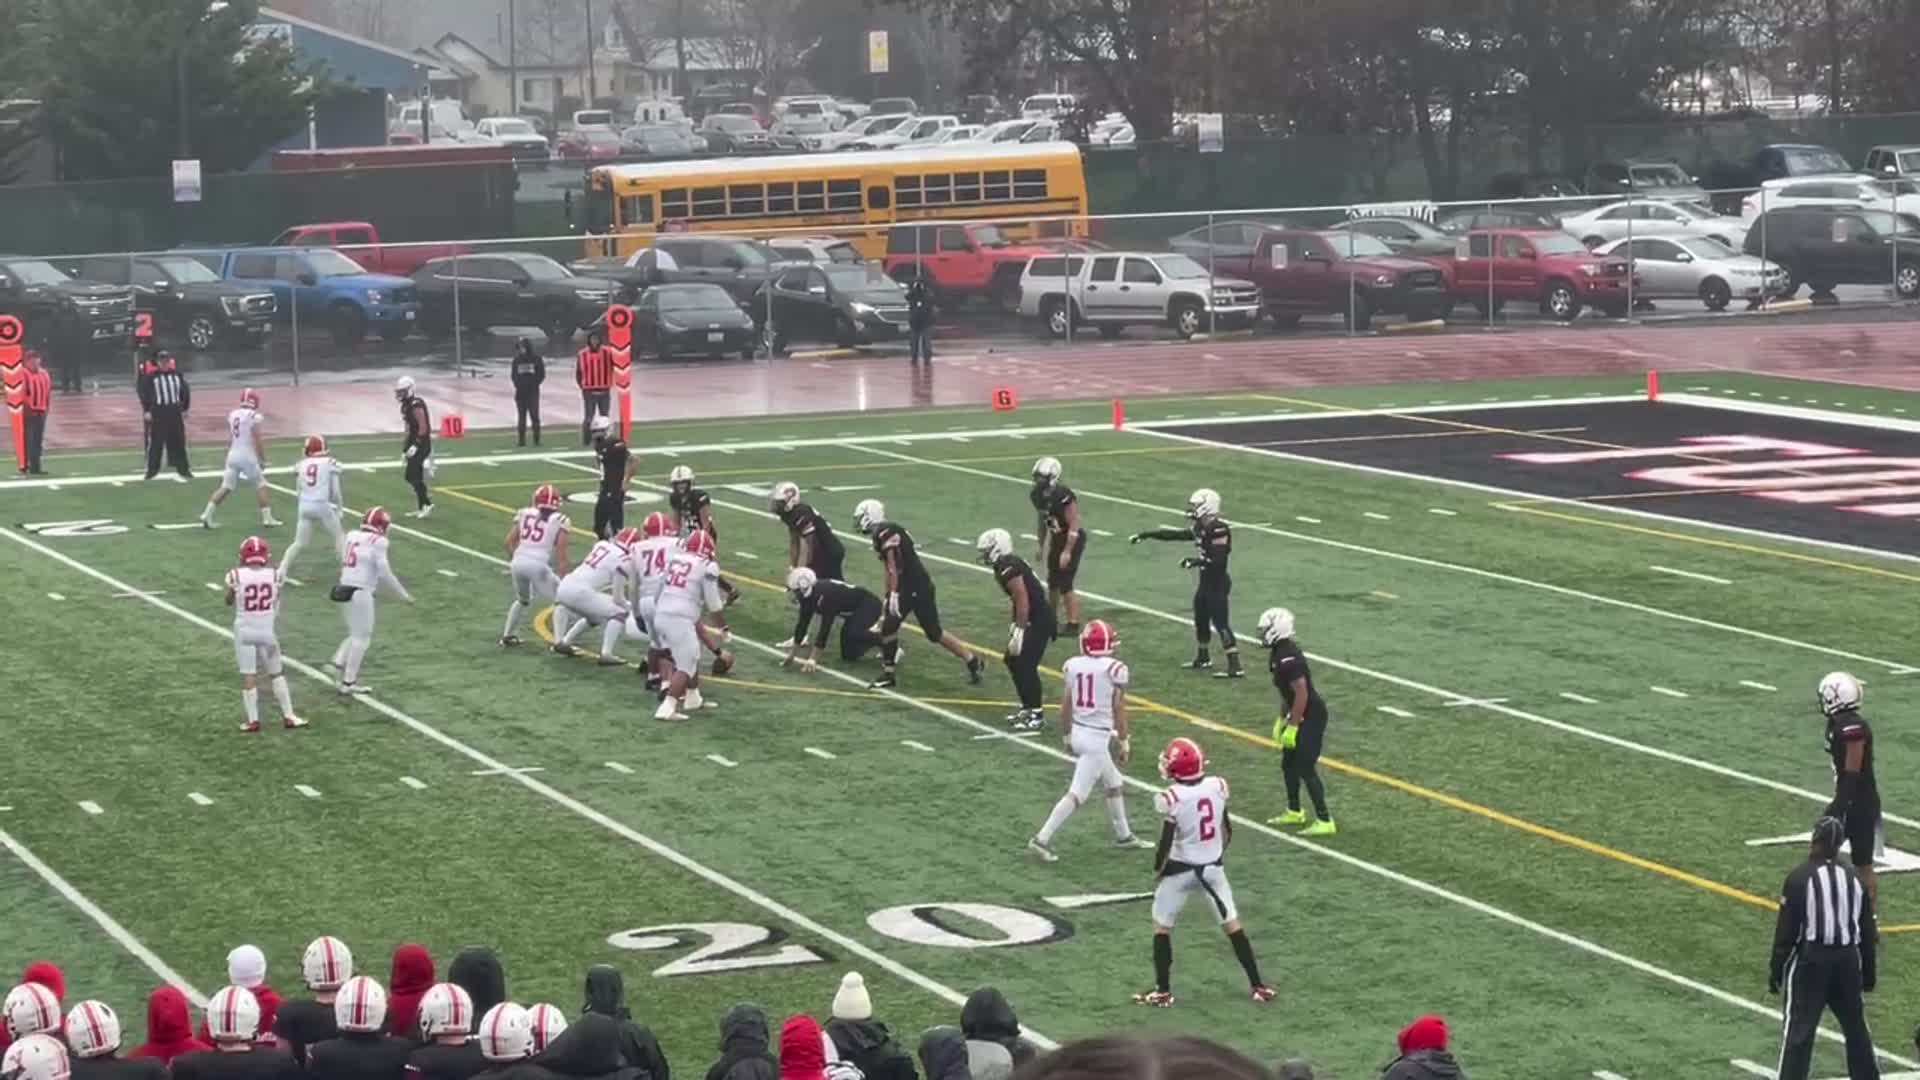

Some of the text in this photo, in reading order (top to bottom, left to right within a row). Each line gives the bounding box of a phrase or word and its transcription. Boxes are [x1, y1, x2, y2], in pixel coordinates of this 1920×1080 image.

[135, 313, 153, 337] 2
[445, 418, 462, 433] 10
[307, 464, 318, 487] 9
[521, 515, 544, 542] 55
[642, 549, 666, 577] 74
[245, 584, 273, 612] 22
[1075, 672, 1095, 708] 11
[1197, 798, 1215, 841] 2
